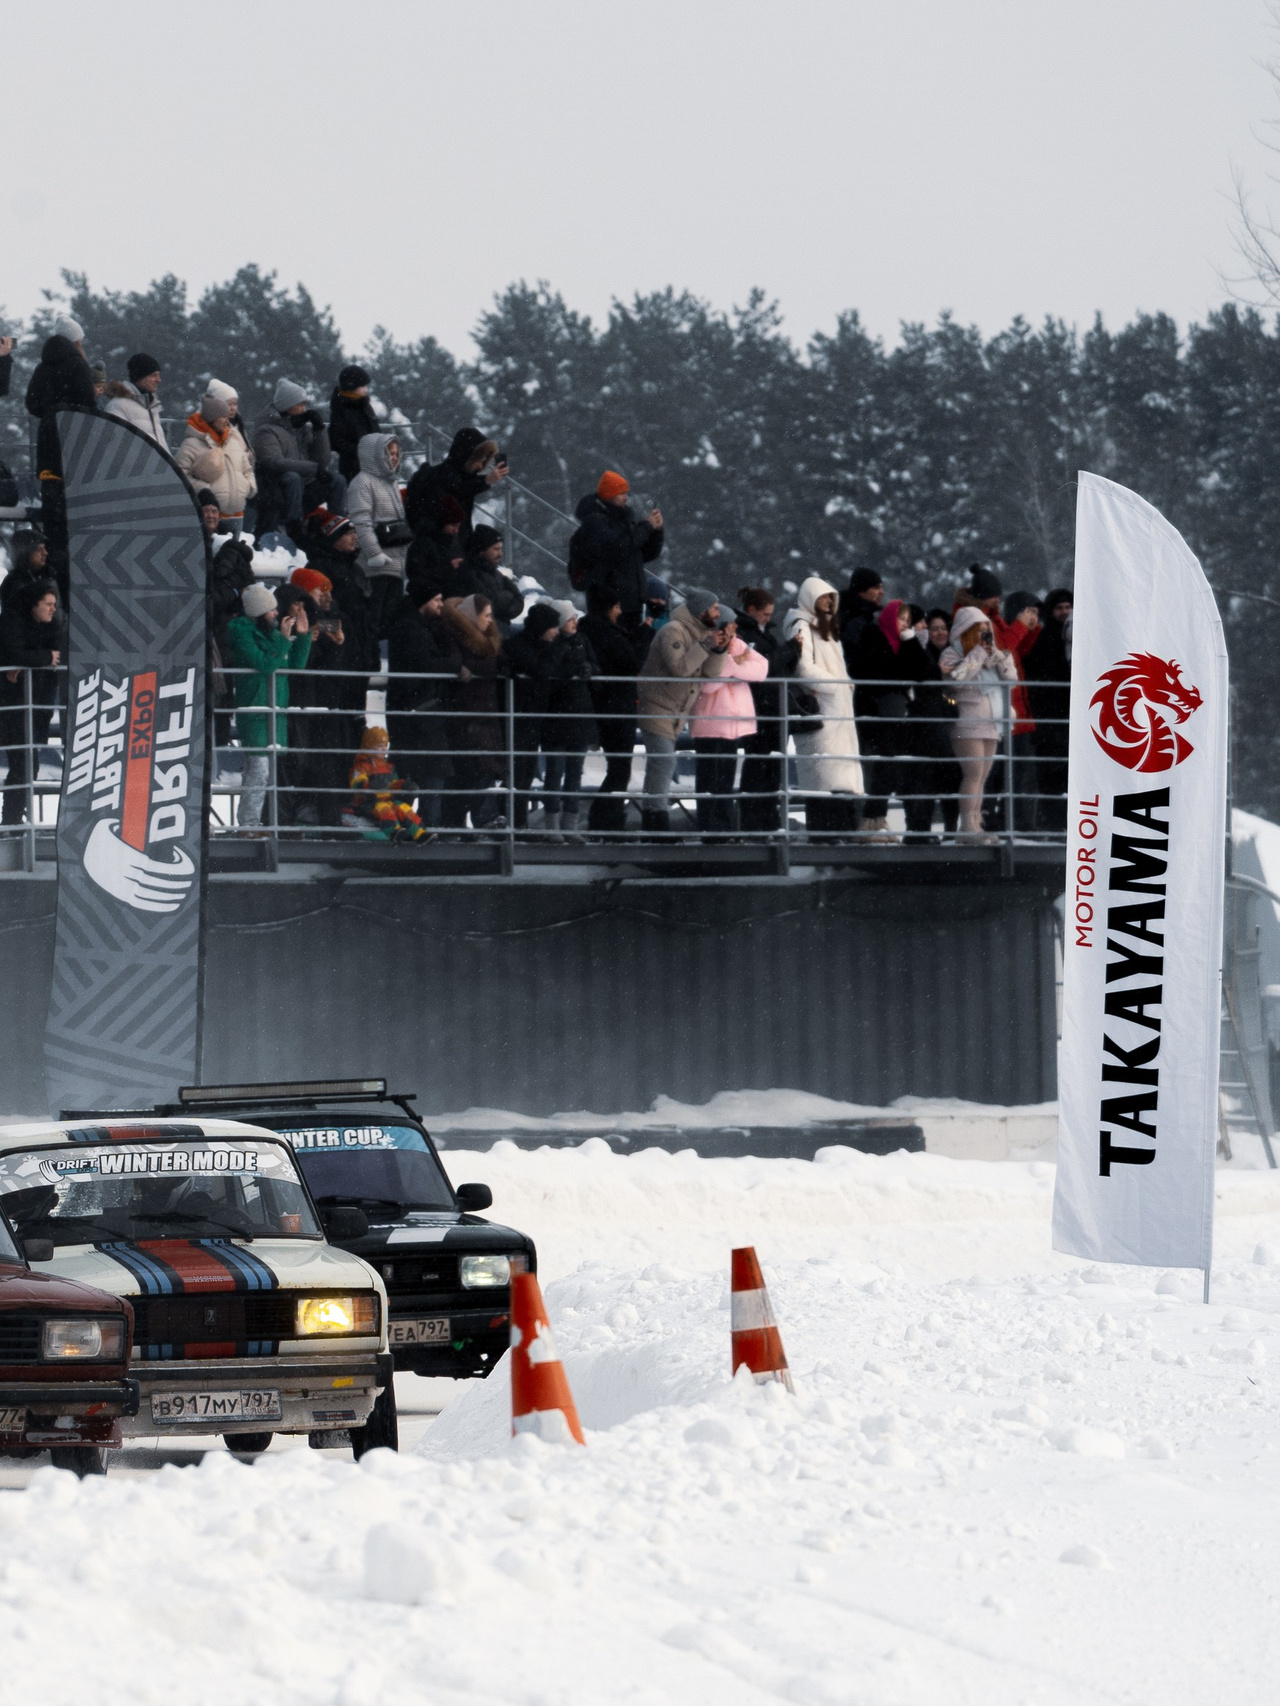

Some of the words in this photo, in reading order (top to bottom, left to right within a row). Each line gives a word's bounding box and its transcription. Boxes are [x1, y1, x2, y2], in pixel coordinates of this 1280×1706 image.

[1078, 794, 1099, 839] OIL
[1075, 847, 1097, 947] MOTOR
[1099, 786, 1170, 1178] TAKAYAMA
[280, 1130, 341, 1148] INTER
[343, 1128, 383, 1145] CUP
[57, 1158, 98, 1170] DRIFT
[100, 1152, 189, 1174] WINTER
[192, 1151, 257, 1172] MODE
[419, 1320, 445, 1335] 797
[242, 1392, 272, 1407] 797
